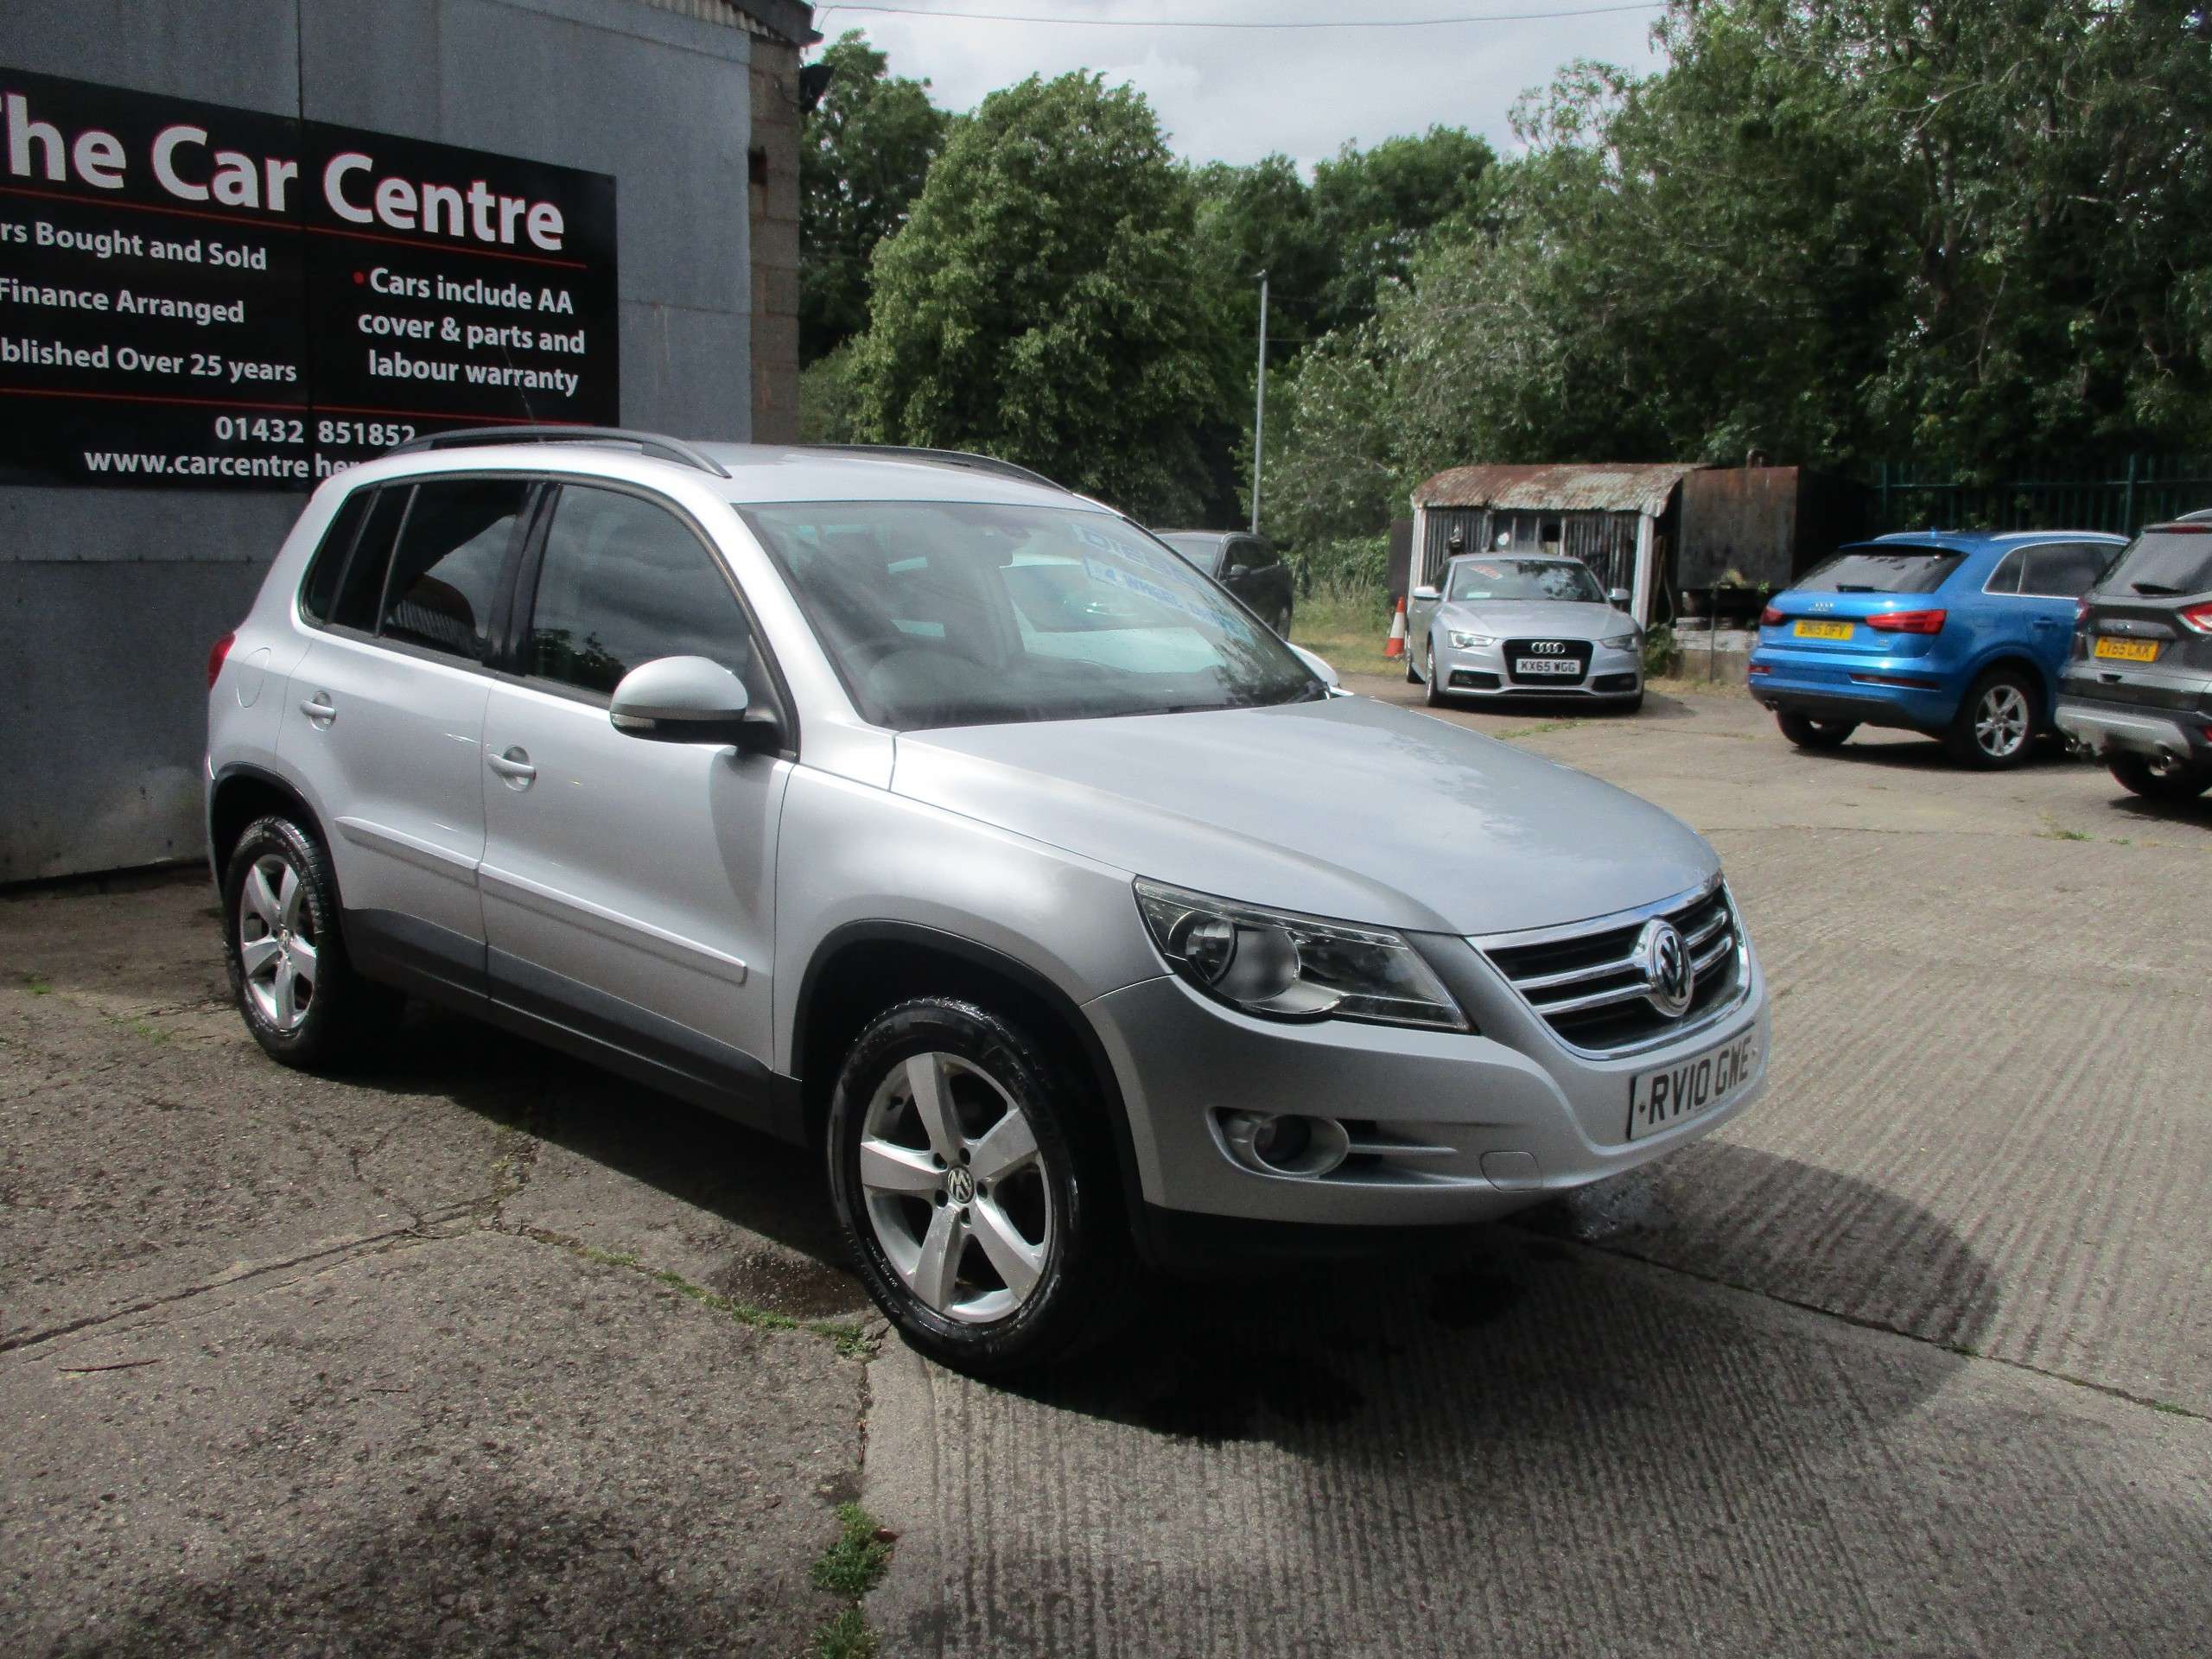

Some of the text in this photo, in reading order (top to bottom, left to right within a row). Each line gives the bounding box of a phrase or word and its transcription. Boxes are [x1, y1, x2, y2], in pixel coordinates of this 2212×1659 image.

[0, 90, 565, 251] he Car Centre
[35, 221, 143, 259] Bought
[149, 239, 201, 264] and
[208, 243, 267, 270] Sold
[0, 277, 245, 326] Finance Arranged
[370, 267, 575, 315] Cars include AA
[358, 314, 586, 354] cover & parts and
[118, 347, 184, 374] Over
[190, 353, 222, 377] 25
[228, 360, 297, 384] years
[369, 349, 579, 397] labour warranty
[215, 416, 416, 446] 01432 851852
[1519, 661, 1551, 672] KX65
